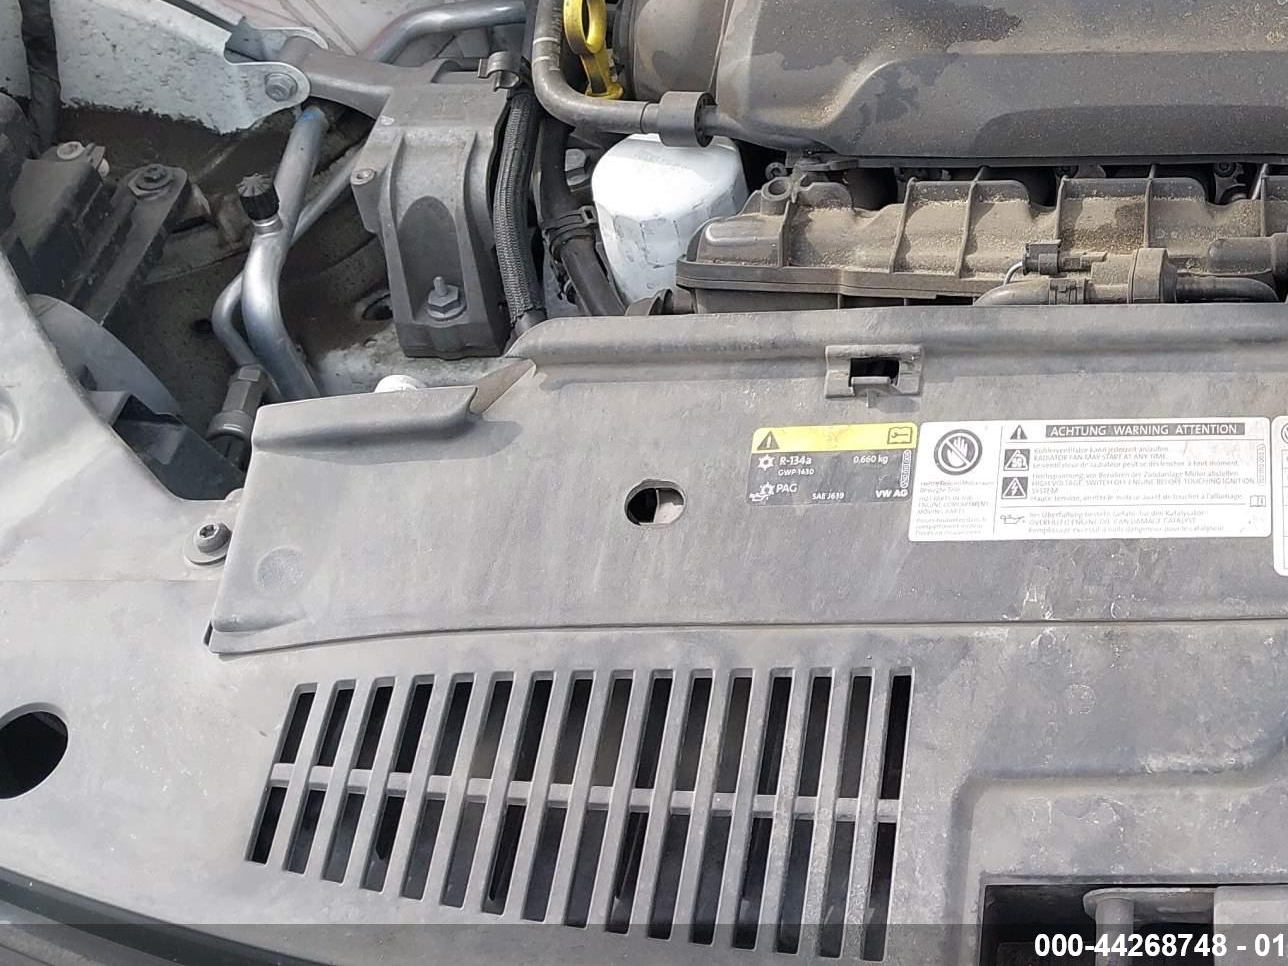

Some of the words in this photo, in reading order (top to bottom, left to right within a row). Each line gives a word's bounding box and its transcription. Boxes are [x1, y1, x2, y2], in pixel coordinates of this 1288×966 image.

[1050, 426, 1107, 436] ACHTUNG
[1113, 425, 1169, 435] WARNING
[1175, 424, 1237, 435] ATTENTION
[779, 455, 812, 466] R-134a
[877, 455, 889, 465] kg
[776, 483, 798, 493] PAG
[812, 492, 827, 500] SAE
[875, 490, 892, 499] VW
[893, 489, 909, 498] AG
